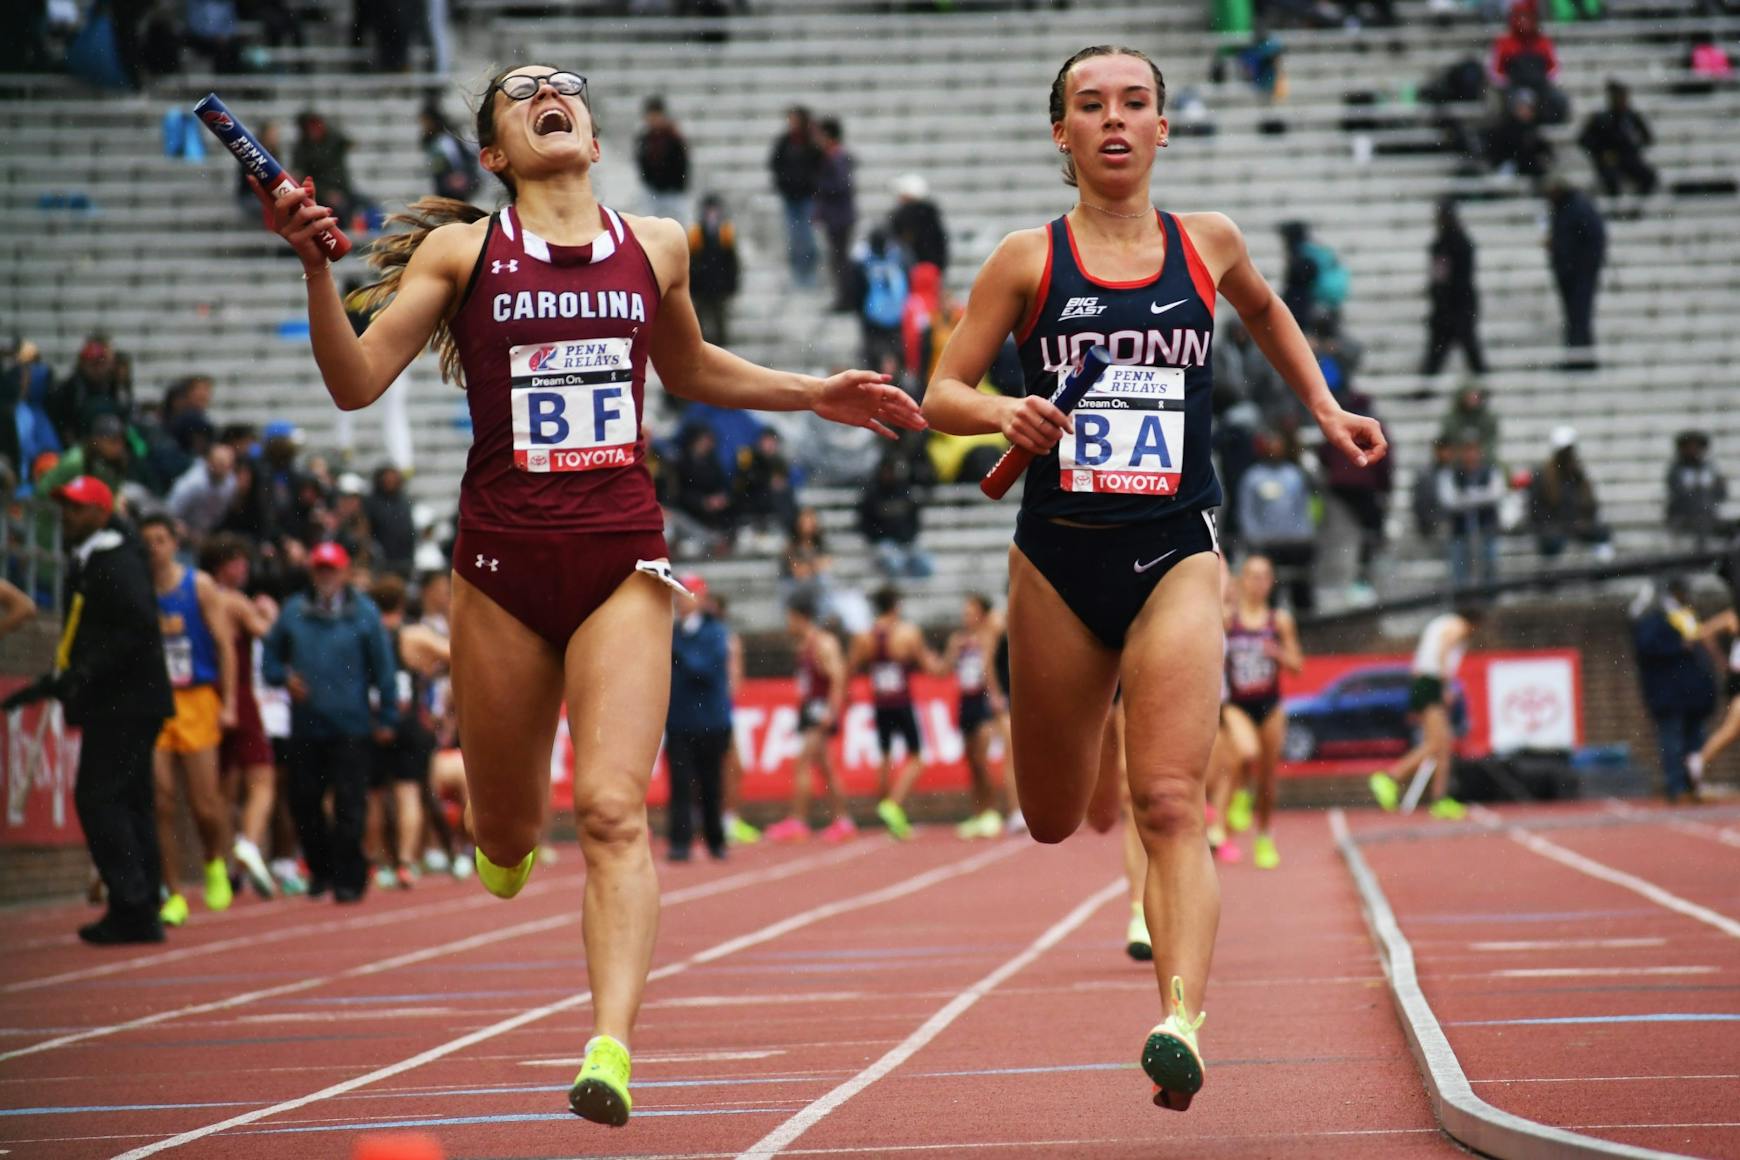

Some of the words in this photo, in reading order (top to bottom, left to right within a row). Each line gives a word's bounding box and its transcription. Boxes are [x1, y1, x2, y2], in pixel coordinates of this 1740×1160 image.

[238, 135, 269, 165] PENN
[229, 141, 269, 180] RELAYS
[493, 291, 645, 323] CAROLINA
[1066, 297, 1099, 307] BIG
[1060, 305, 1108, 317] EAST
[565, 343, 608, 356] PENN
[1040, 328, 1211, 373] UCONN
[563, 354, 620, 368] RELAYS
[531, 377, 565, 387] Dream
[1112, 370, 1155, 381] PENN
[1111, 382, 1168, 394] RELAYS
[1078, 399, 1110, 409] Dream
[528, 392, 570, 445] B
[592, 387, 622, 442] F
[1075, 413, 1113, 467] B
[1128, 414, 1172, 468] A
[554, 448, 626, 467] TOYOTA
[1097, 475, 1170, 491] TOYOTA
